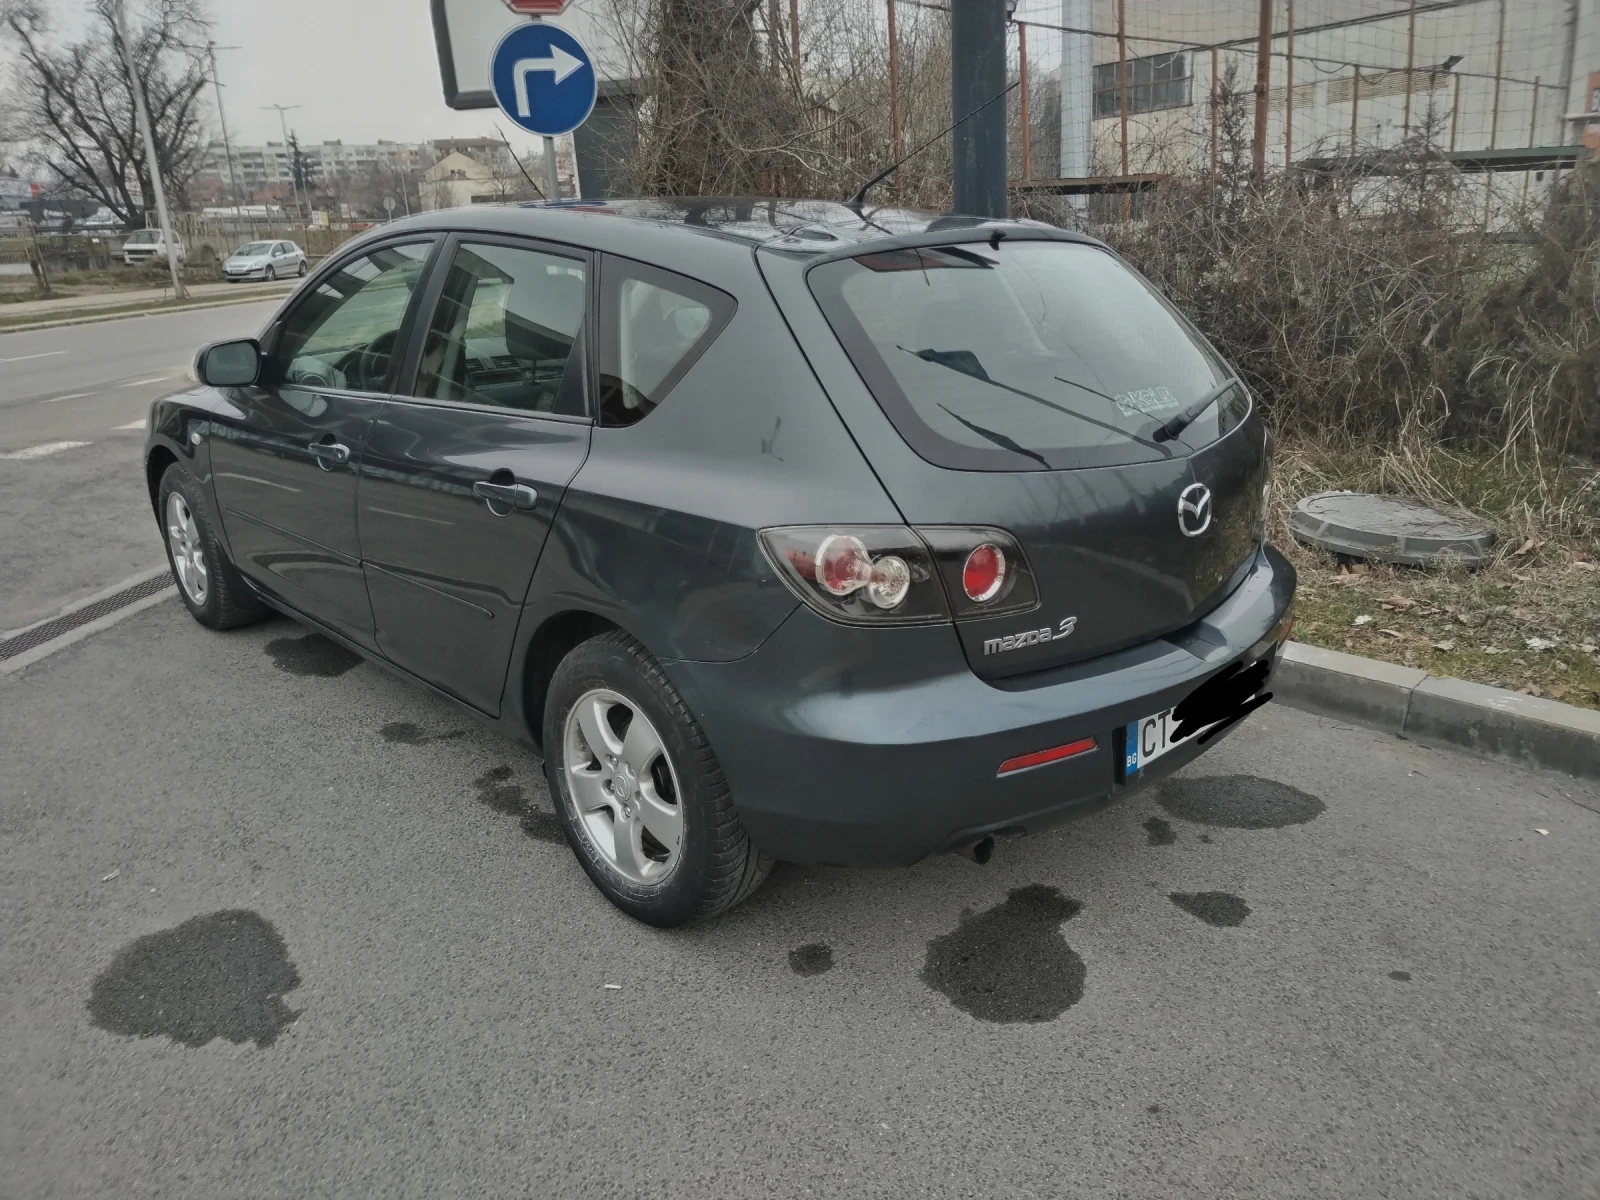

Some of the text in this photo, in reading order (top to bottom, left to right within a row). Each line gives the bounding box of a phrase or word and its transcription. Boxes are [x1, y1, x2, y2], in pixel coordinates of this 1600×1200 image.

[1052, 616, 1078, 640] 3
[1142, 708, 1172, 758] CT
[1126, 752, 1137, 768] BG
